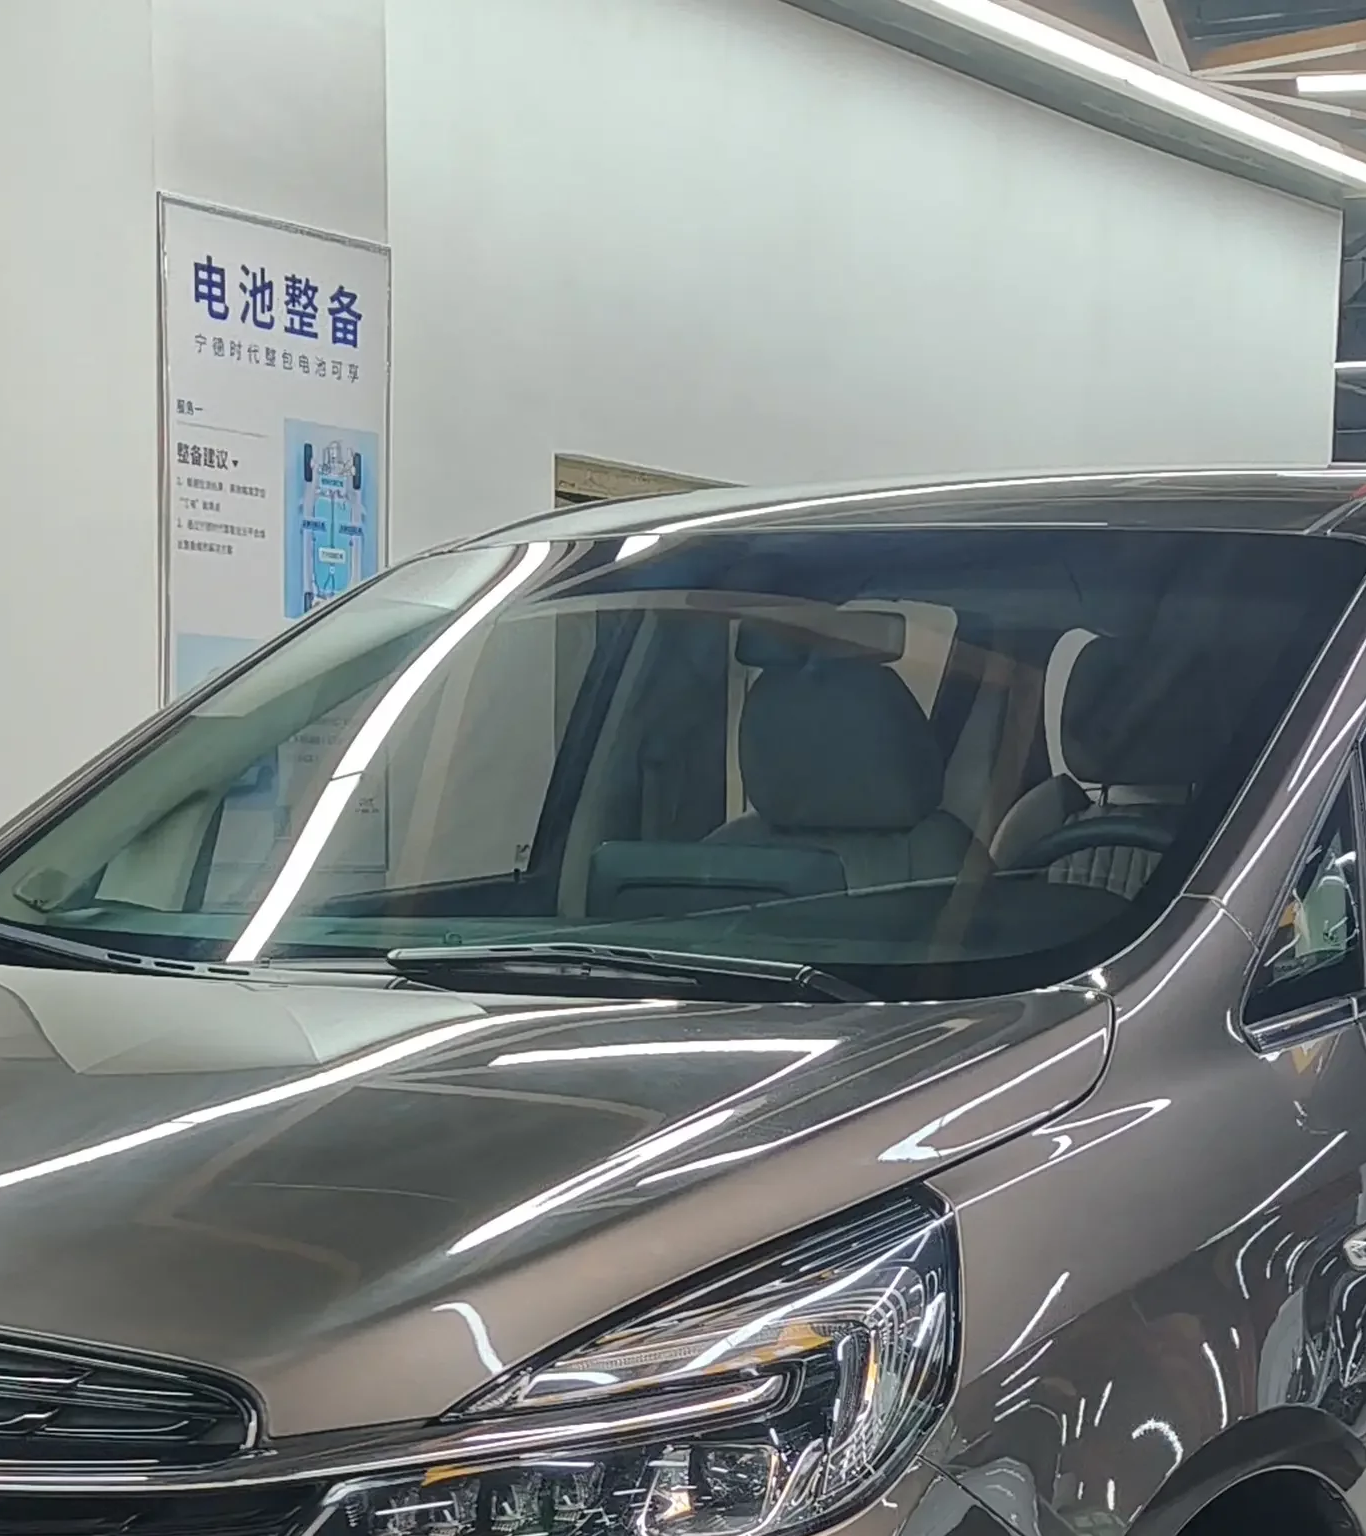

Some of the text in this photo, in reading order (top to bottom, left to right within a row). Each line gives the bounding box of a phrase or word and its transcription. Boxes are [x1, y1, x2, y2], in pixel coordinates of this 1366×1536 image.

[193, 254, 363, 348] 电池整备
[194, 333, 360, 383] 宁德时代整包电池可享
[177, 441, 229, 470] 整备建议
